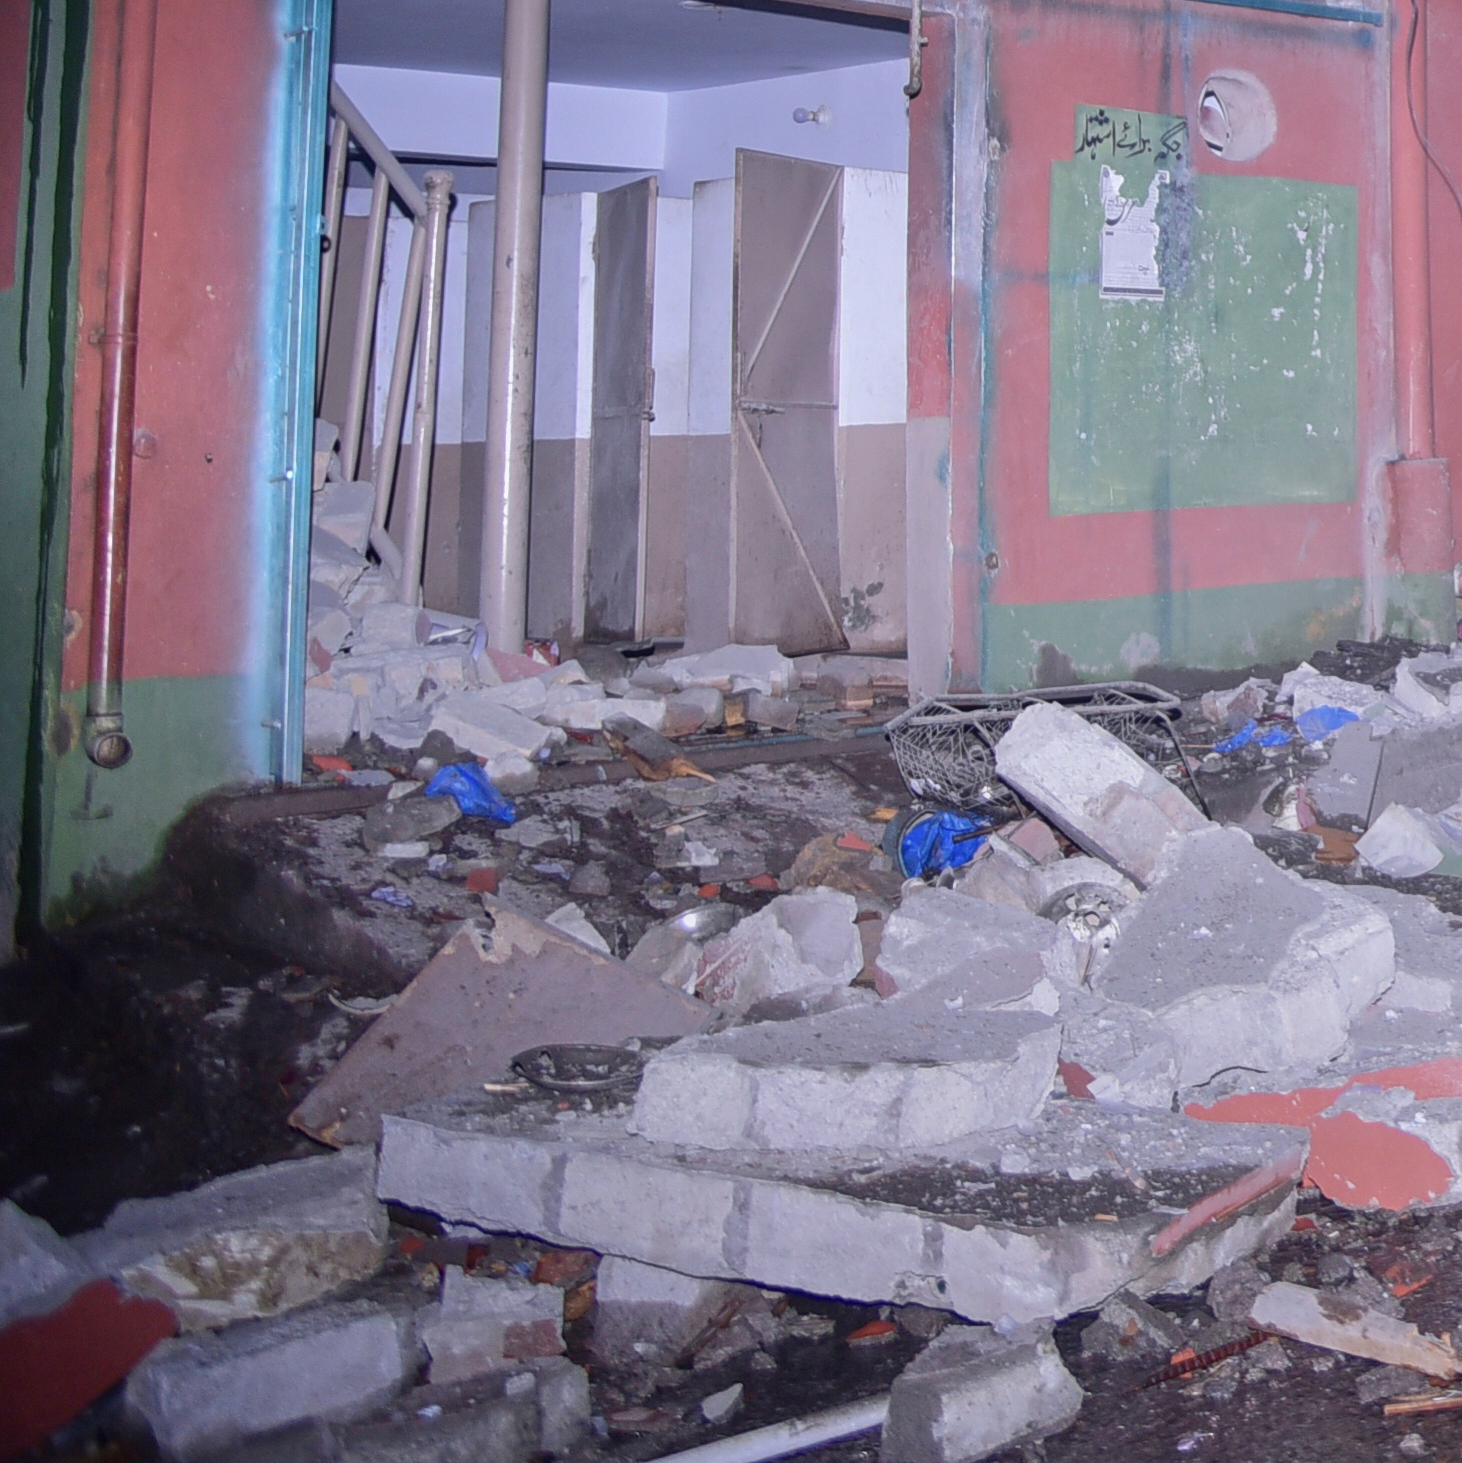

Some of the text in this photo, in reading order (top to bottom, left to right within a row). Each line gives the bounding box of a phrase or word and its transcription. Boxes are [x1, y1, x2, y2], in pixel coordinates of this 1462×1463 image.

[1075, 108, 1187, 162] جگہ برائے اشتہار
